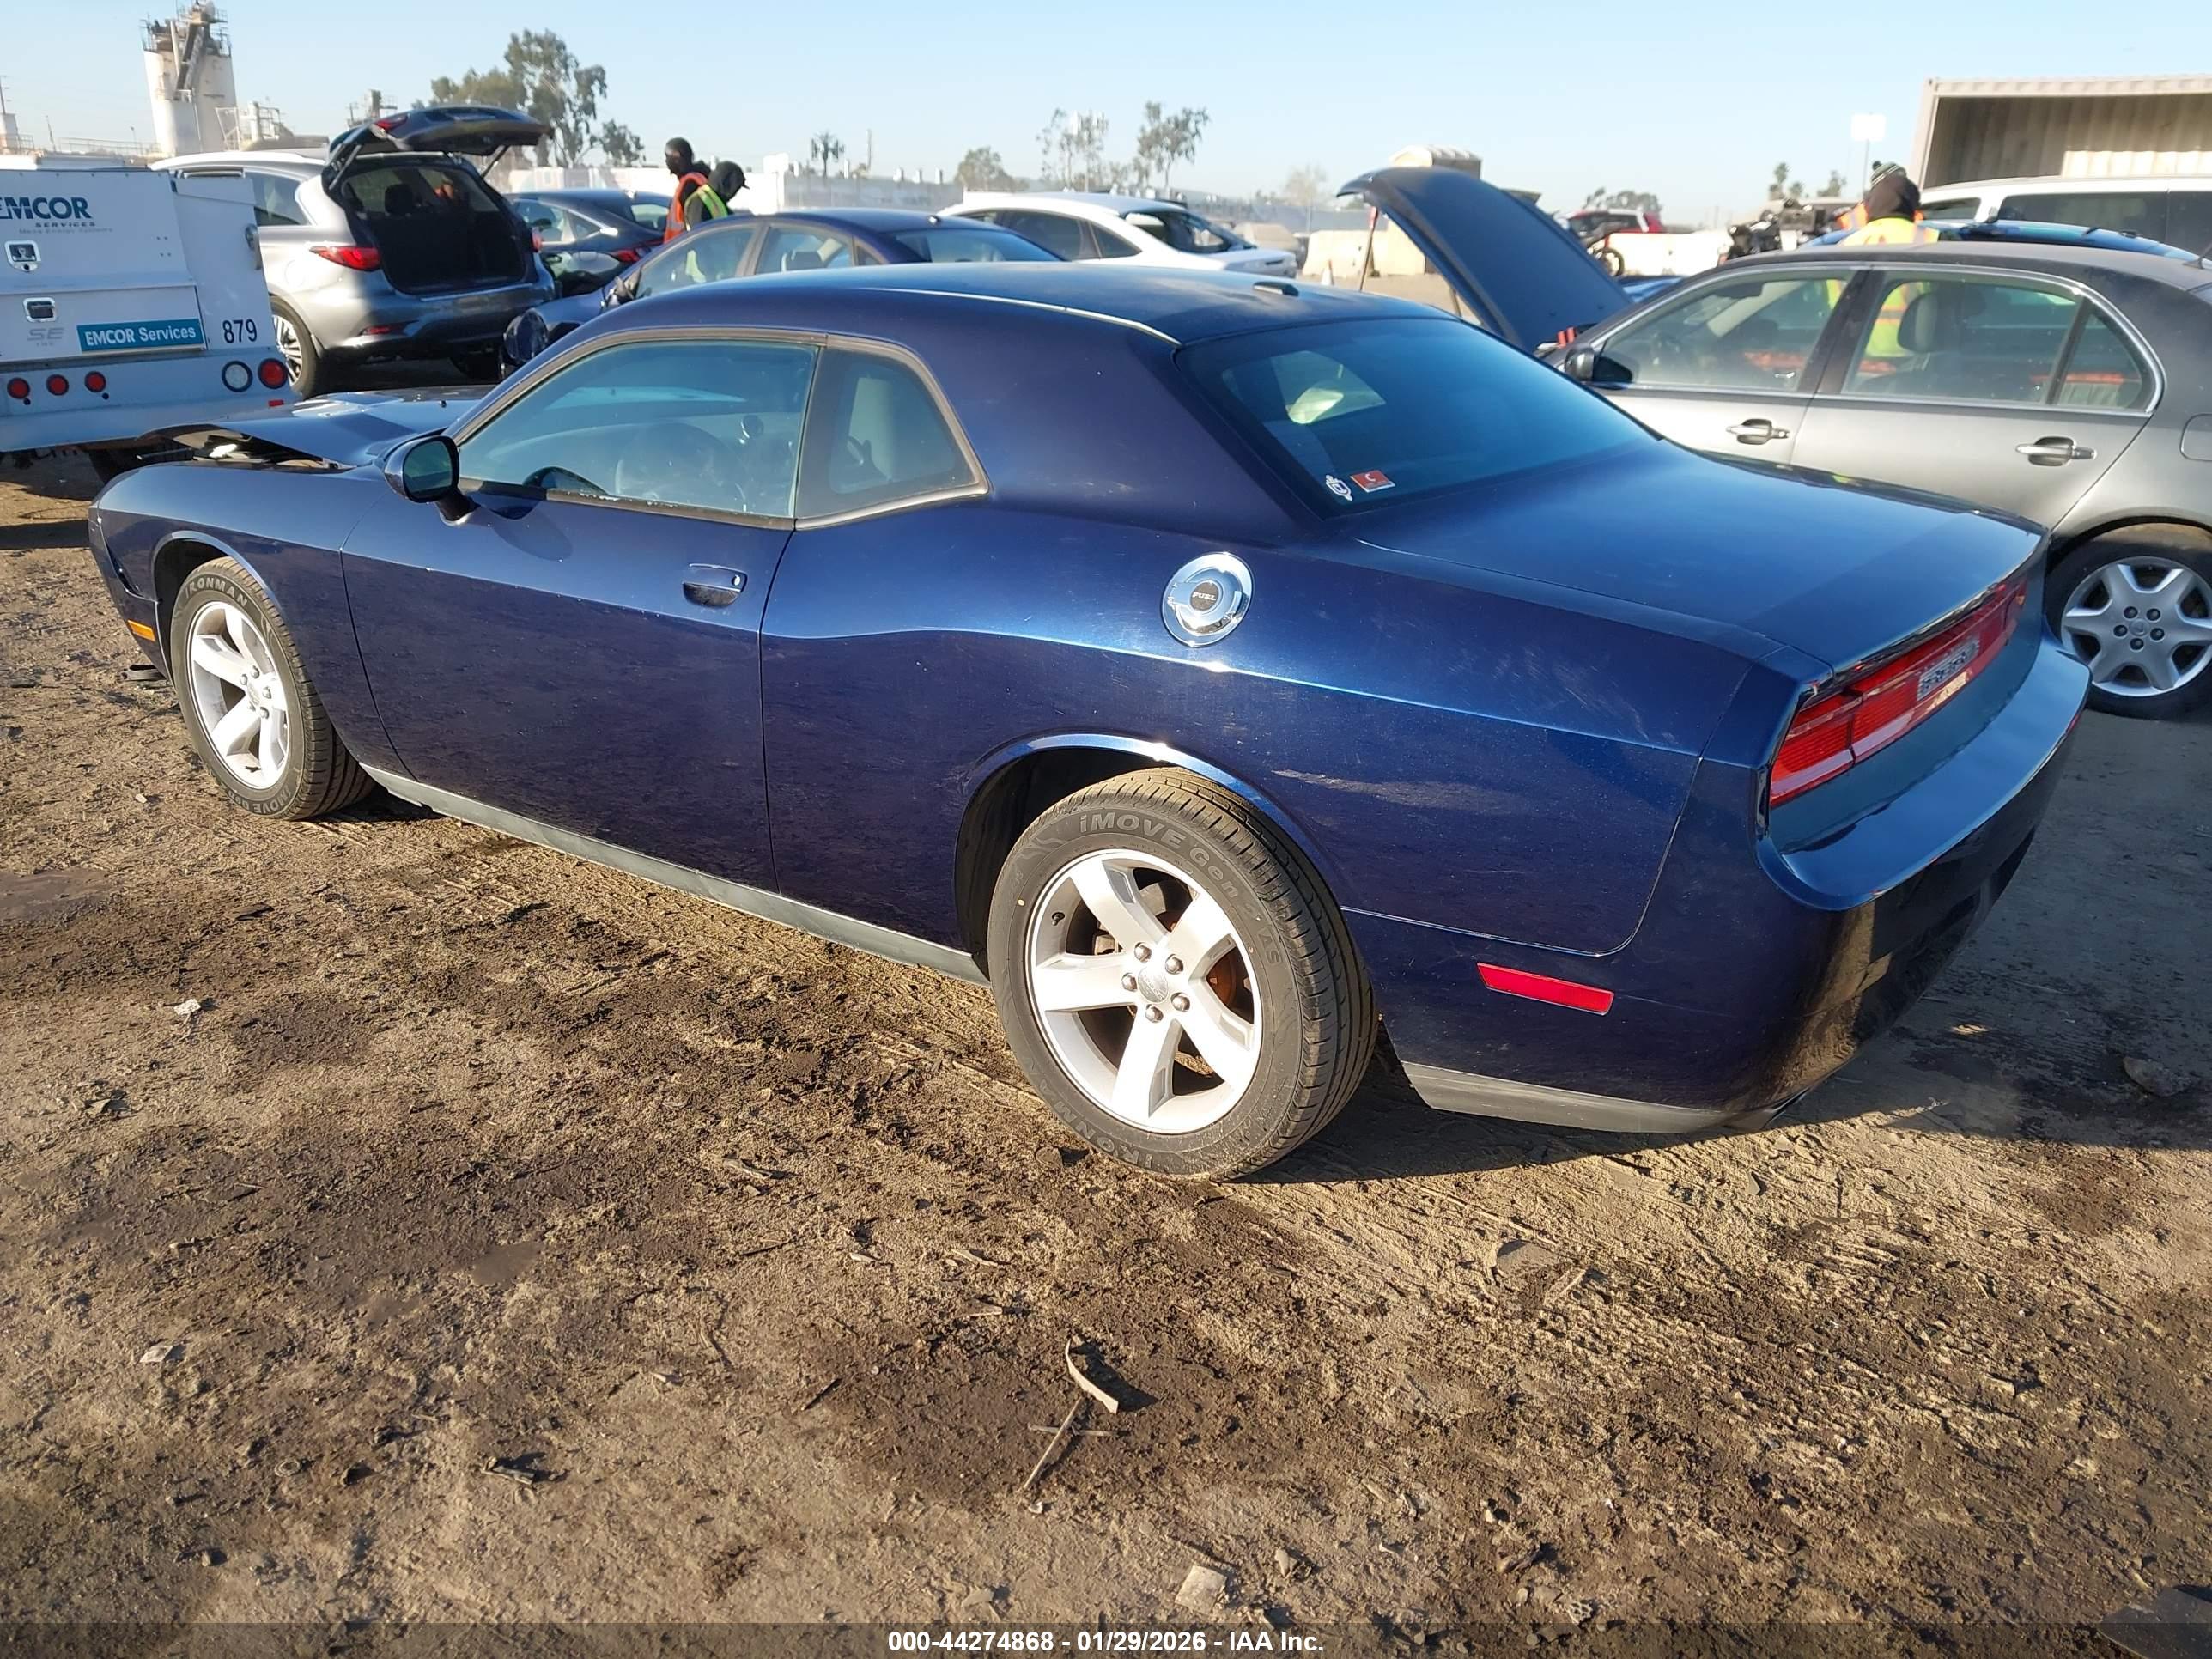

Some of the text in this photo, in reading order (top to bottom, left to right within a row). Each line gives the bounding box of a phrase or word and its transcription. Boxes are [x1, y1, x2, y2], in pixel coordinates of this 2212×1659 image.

[84, 325, 197, 347] EMCOR Services
[222, 319, 258, 343] 879
[185, 577, 248, 607] IRONMAN
[1192, 592, 1217, 601] FUEL
[1079, 811, 1186, 847] iMOVE
[1189, 846, 1238, 899] Gen
